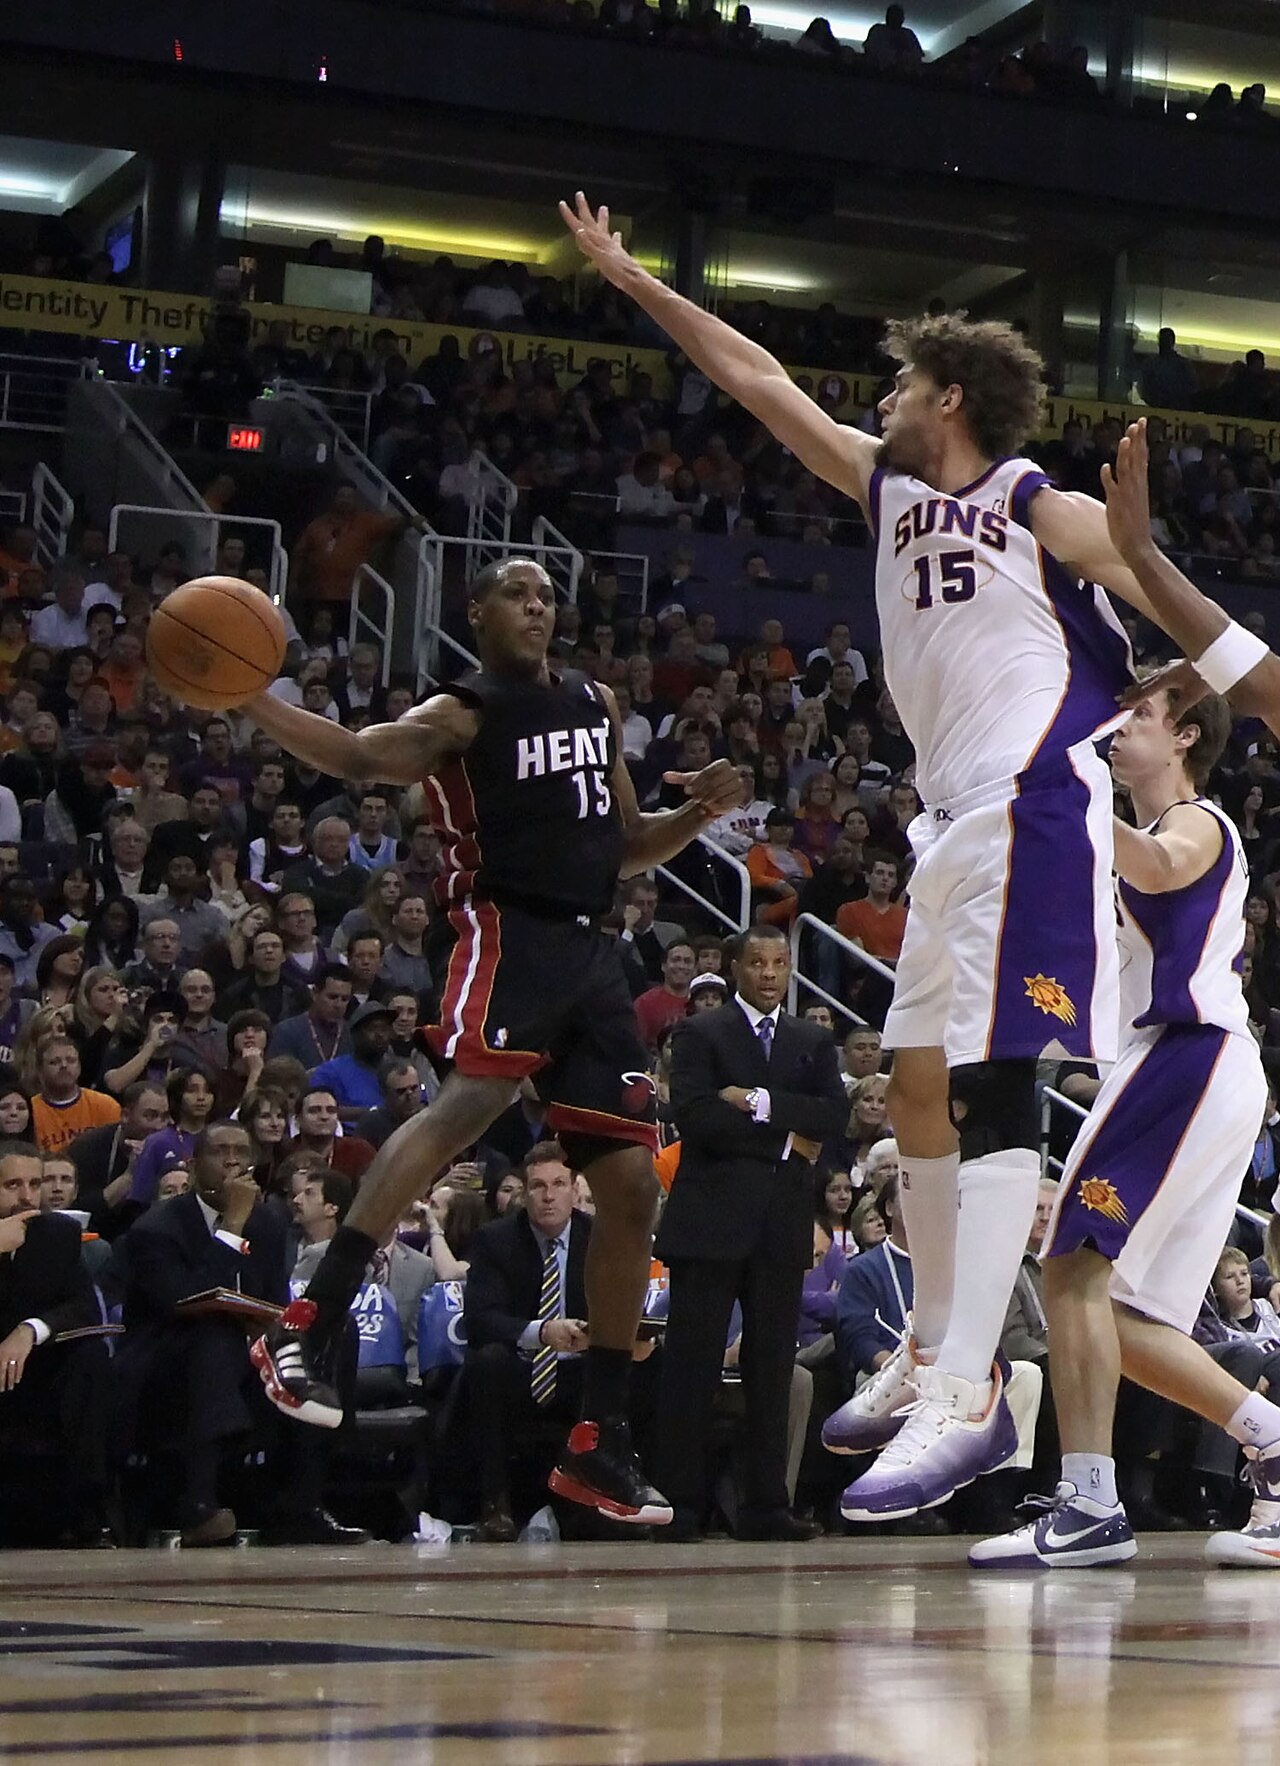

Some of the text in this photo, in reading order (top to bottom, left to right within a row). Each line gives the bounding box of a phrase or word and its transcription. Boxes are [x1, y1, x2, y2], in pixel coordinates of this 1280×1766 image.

[894, 499, 1008, 560] SUNS
[914, 550, 977, 611] 15
[517, 717, 610, 780] HEAT
[572, 771, 612, 819] 15
